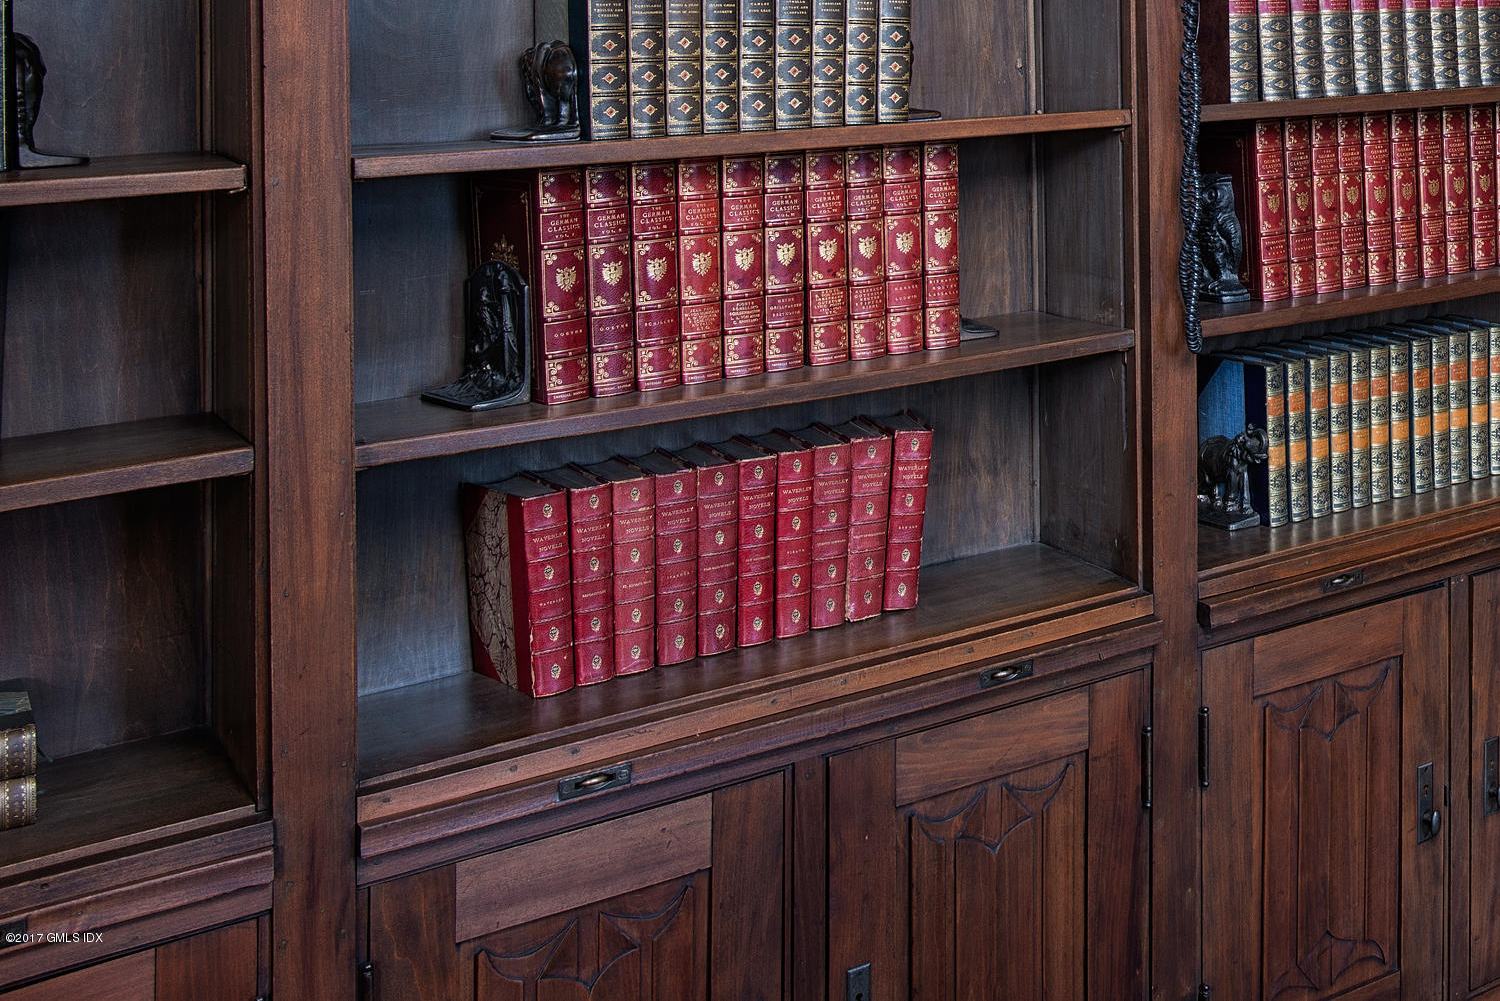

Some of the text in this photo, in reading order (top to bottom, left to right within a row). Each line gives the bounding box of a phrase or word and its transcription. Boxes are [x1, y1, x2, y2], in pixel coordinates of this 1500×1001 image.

[594, 220, 627, 228] CLASSICS
[640, 216, 673, 224] CLASSICS
[548, 224, 580, 232] CLASSICS
[858, 472, 887, 480] WAVERLEY
[819, 478, 848, 487] WAVERLEY
[782, 486, 812, 495] WAVERLEY
[824, 488, 845, 496] NOVELS
[743, 492, 774, 501] WAVERLEY
[788, 496, 809, 504] NOVELS
[704, 500, 735, 510] WAVERLEY
[749, 501, 771, 510] NOVELS
[661, 506, 694, 517] WAVERLEY
[708, 510, 731, 519] NOVELS
[620, 515, 653, 525] WAVERLEY
[667, 518, 690, 526] NOVELS
[577, 523, 610, 534] WAVERLEY
[626, 526, 649, 534] NOVELS
[533, 531, 566, 543] WAVERLEY
[582, 534, 606, 543] NOVELS
[539, 542, 563, 552] NOVELS
